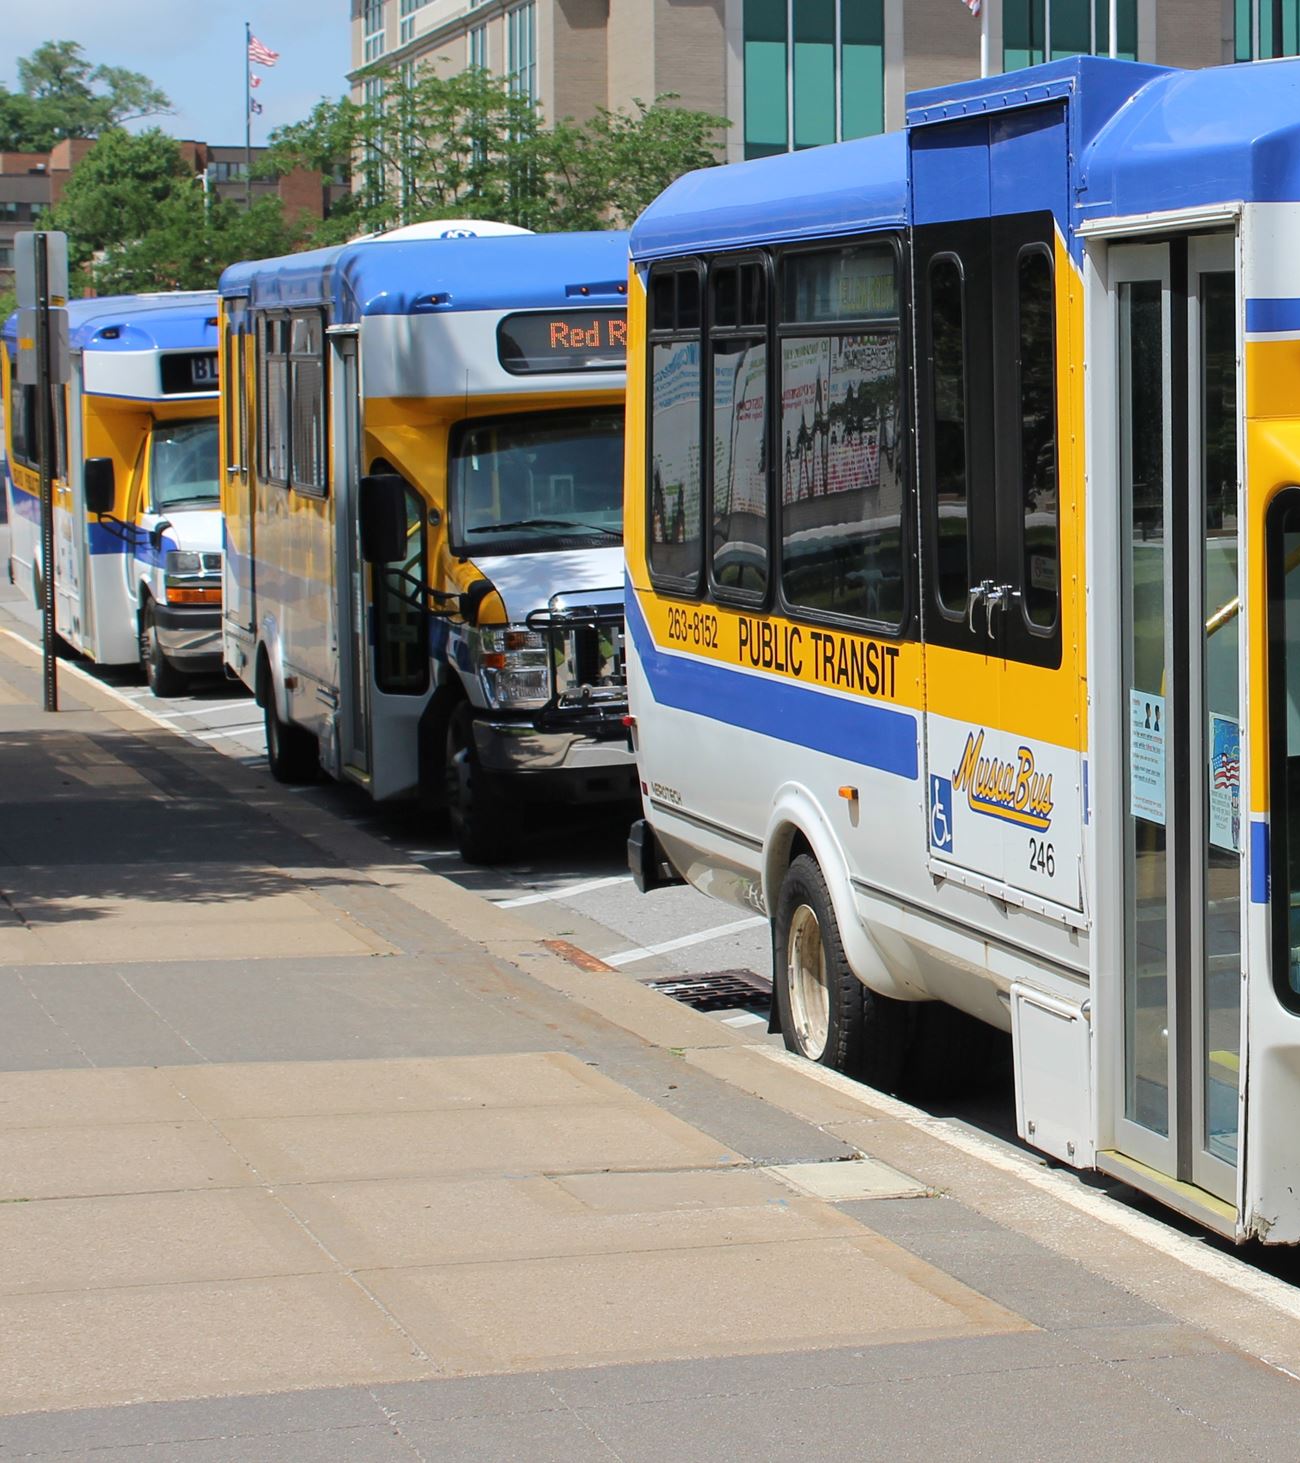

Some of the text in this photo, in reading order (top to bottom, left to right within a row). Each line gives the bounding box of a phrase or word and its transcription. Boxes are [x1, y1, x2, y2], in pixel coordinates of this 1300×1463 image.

[550, 320, 600, 348] Red
[668, 607, 718, 648] 263-8152
[739, 617, 899, 698] PUBLIC TRANSIT
[1029, 837, 1055, 877] 246
